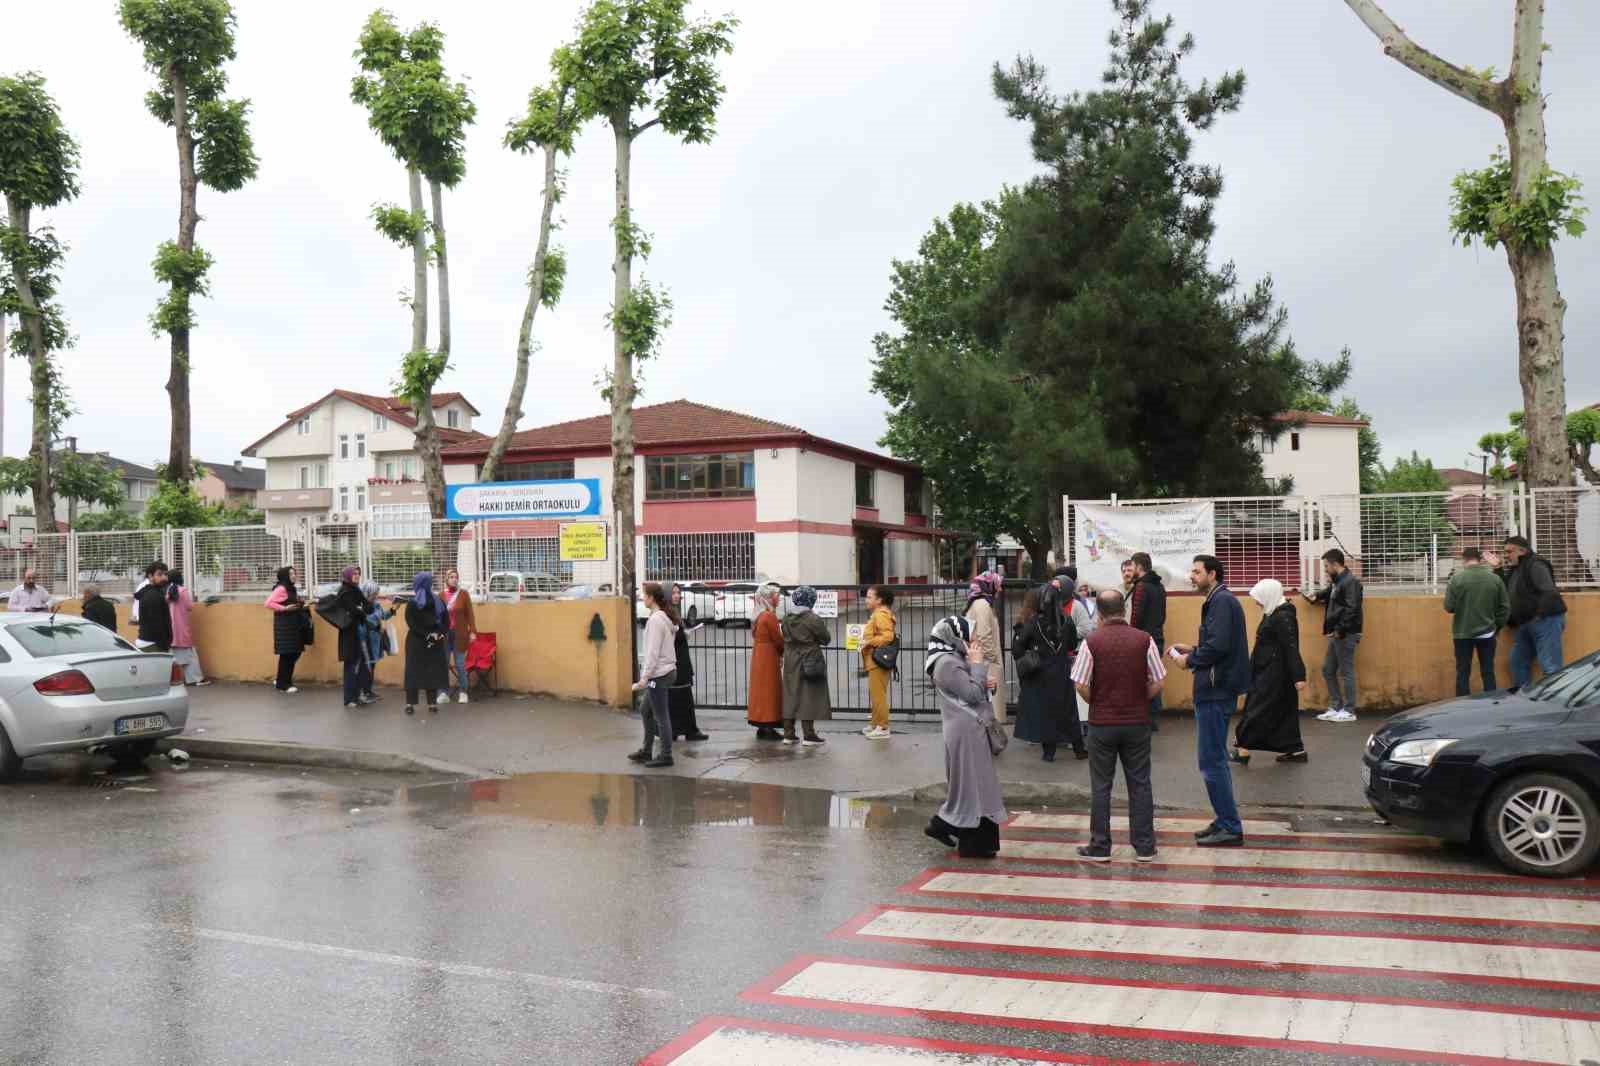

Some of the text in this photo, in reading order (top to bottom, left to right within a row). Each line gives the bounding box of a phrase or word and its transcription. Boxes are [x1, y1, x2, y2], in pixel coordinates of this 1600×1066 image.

[479, 498, 581, 512] HAKKI DEMİR ORTAOKULU
